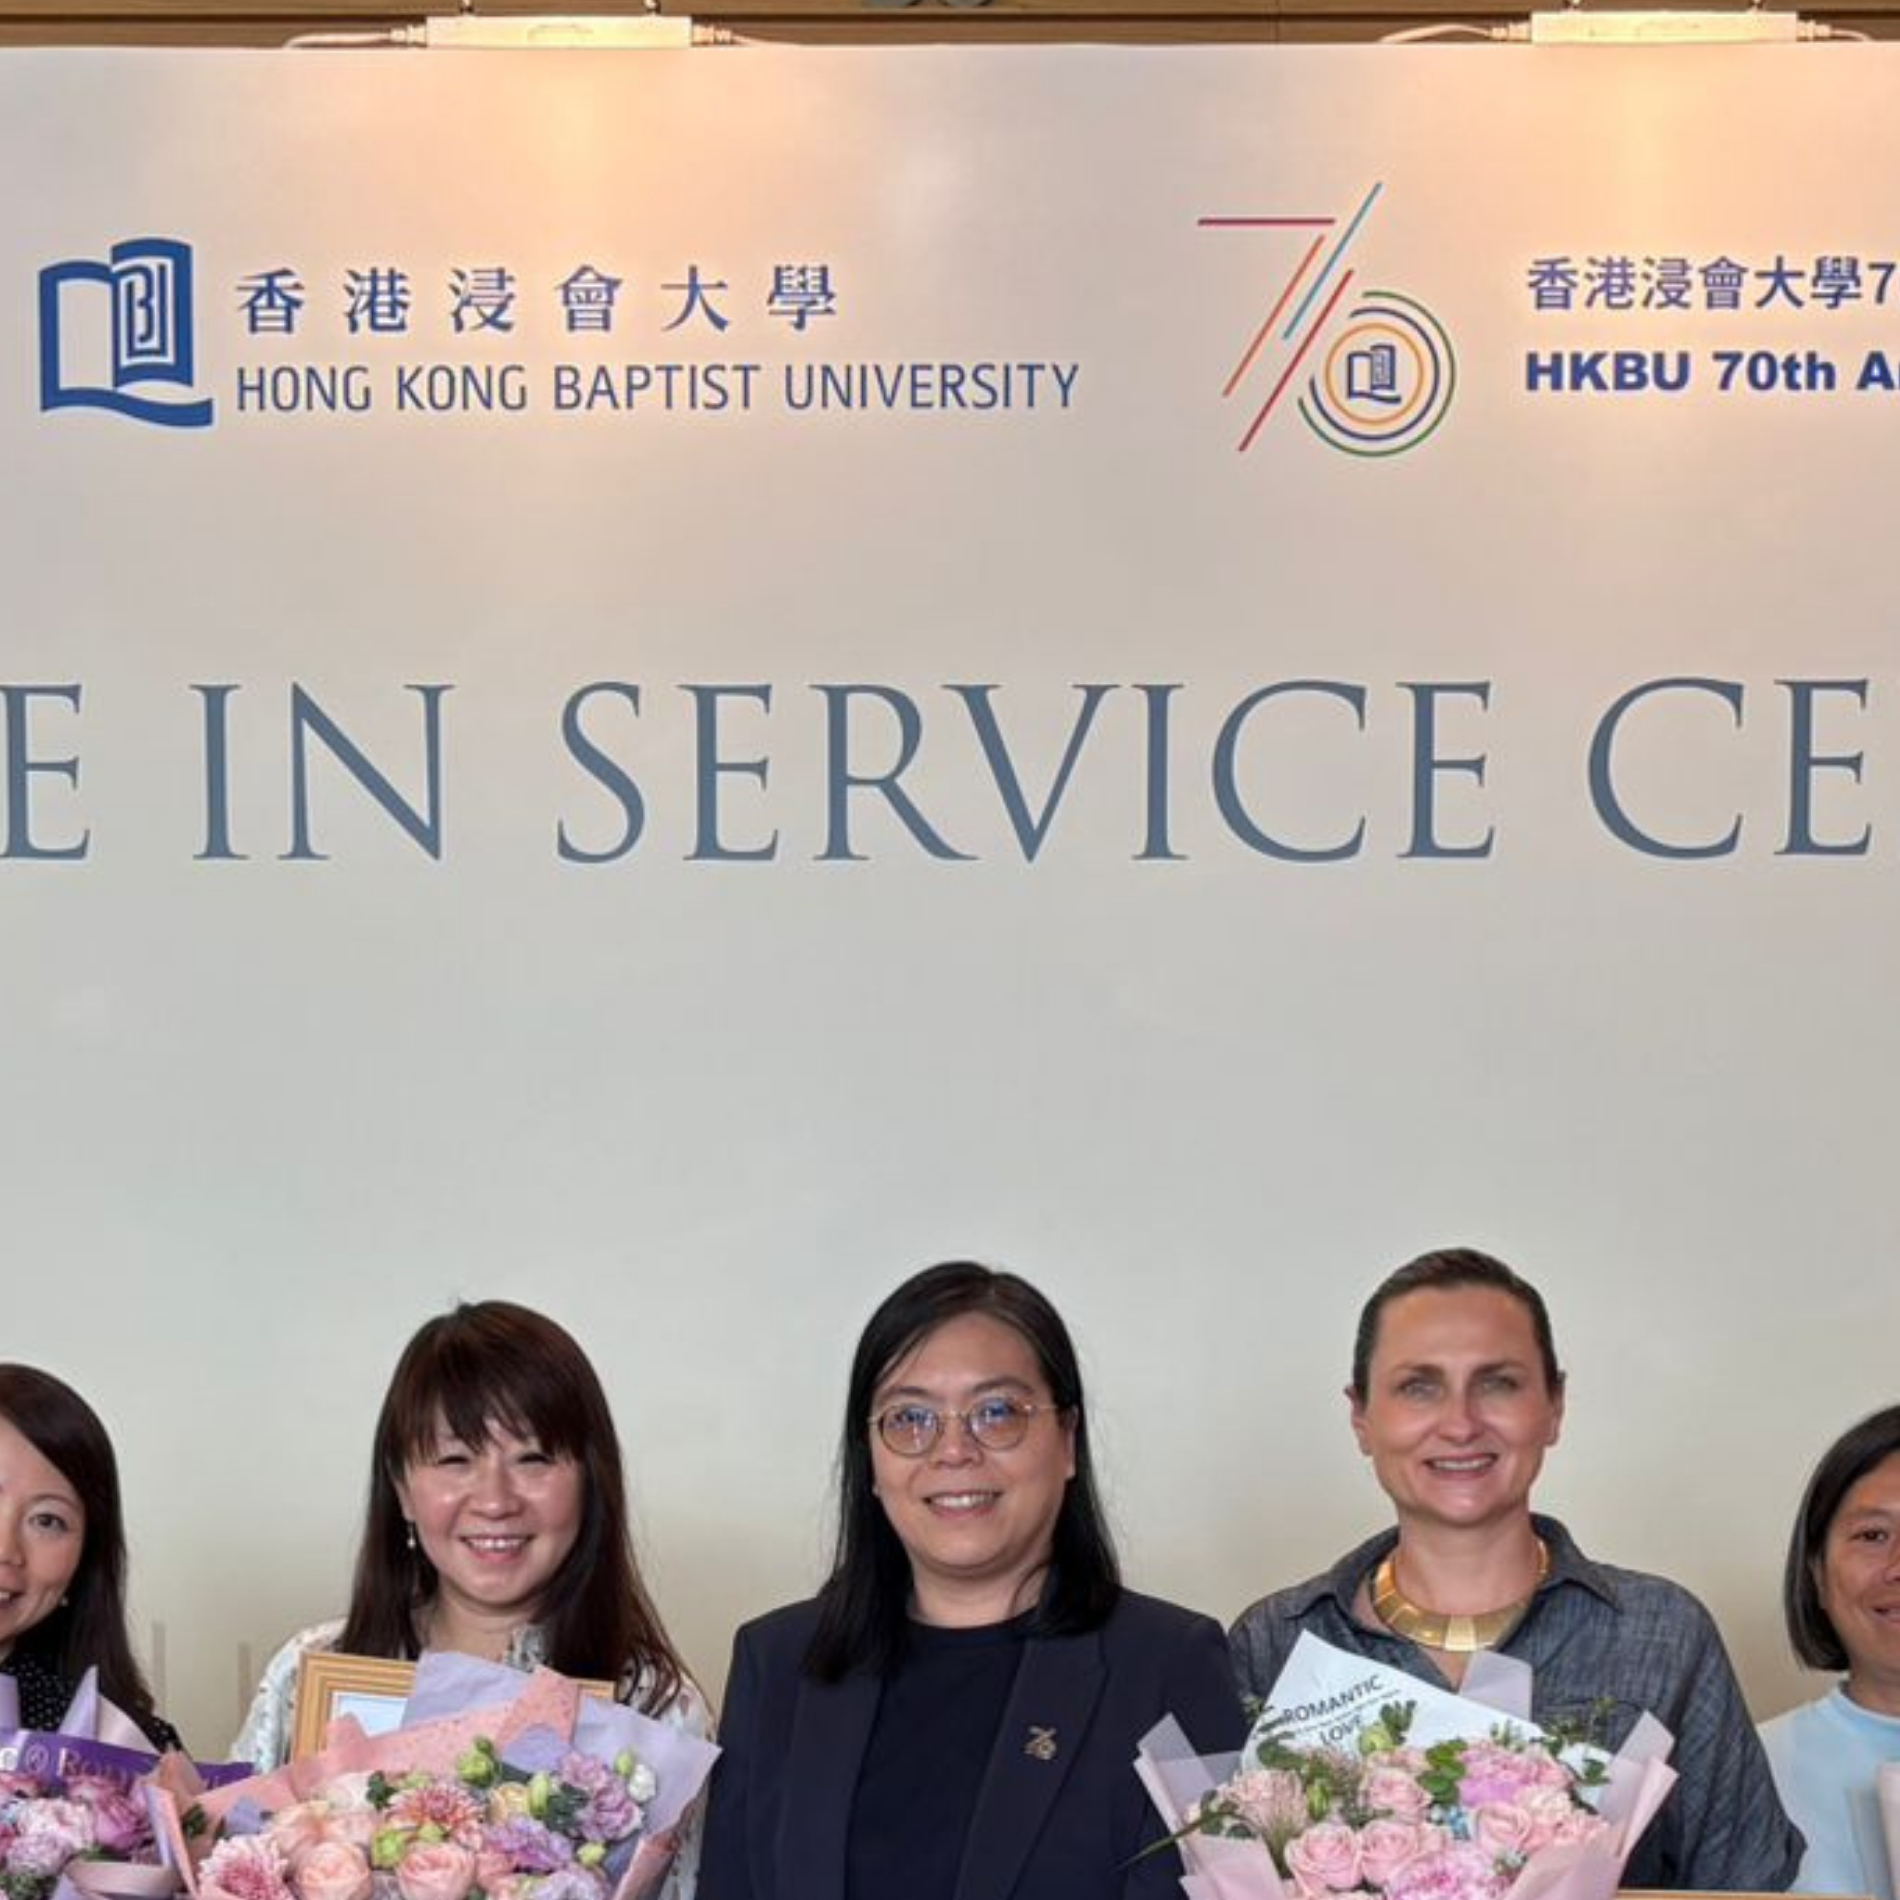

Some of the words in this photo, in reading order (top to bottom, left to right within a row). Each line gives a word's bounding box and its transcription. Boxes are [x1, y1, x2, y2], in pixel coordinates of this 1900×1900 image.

[235, 262, 838, 336] 香港浸會大學
[237, 364, 372, 414] HONG
[396, 363, 528, 414] KONG
[553, 363, 762, 412] BAPTIST
[784, 362, 1080, 411] UNIVERSITY
[1525, 350, 1692, 394] HKBU
[1711, 349, 1837, 394] 70th
[188, 681, 457, 863] IN
[556, 679, 1495, 866] SERVICE
[1282, 1674, 1384, 1723] ROMANTIC
